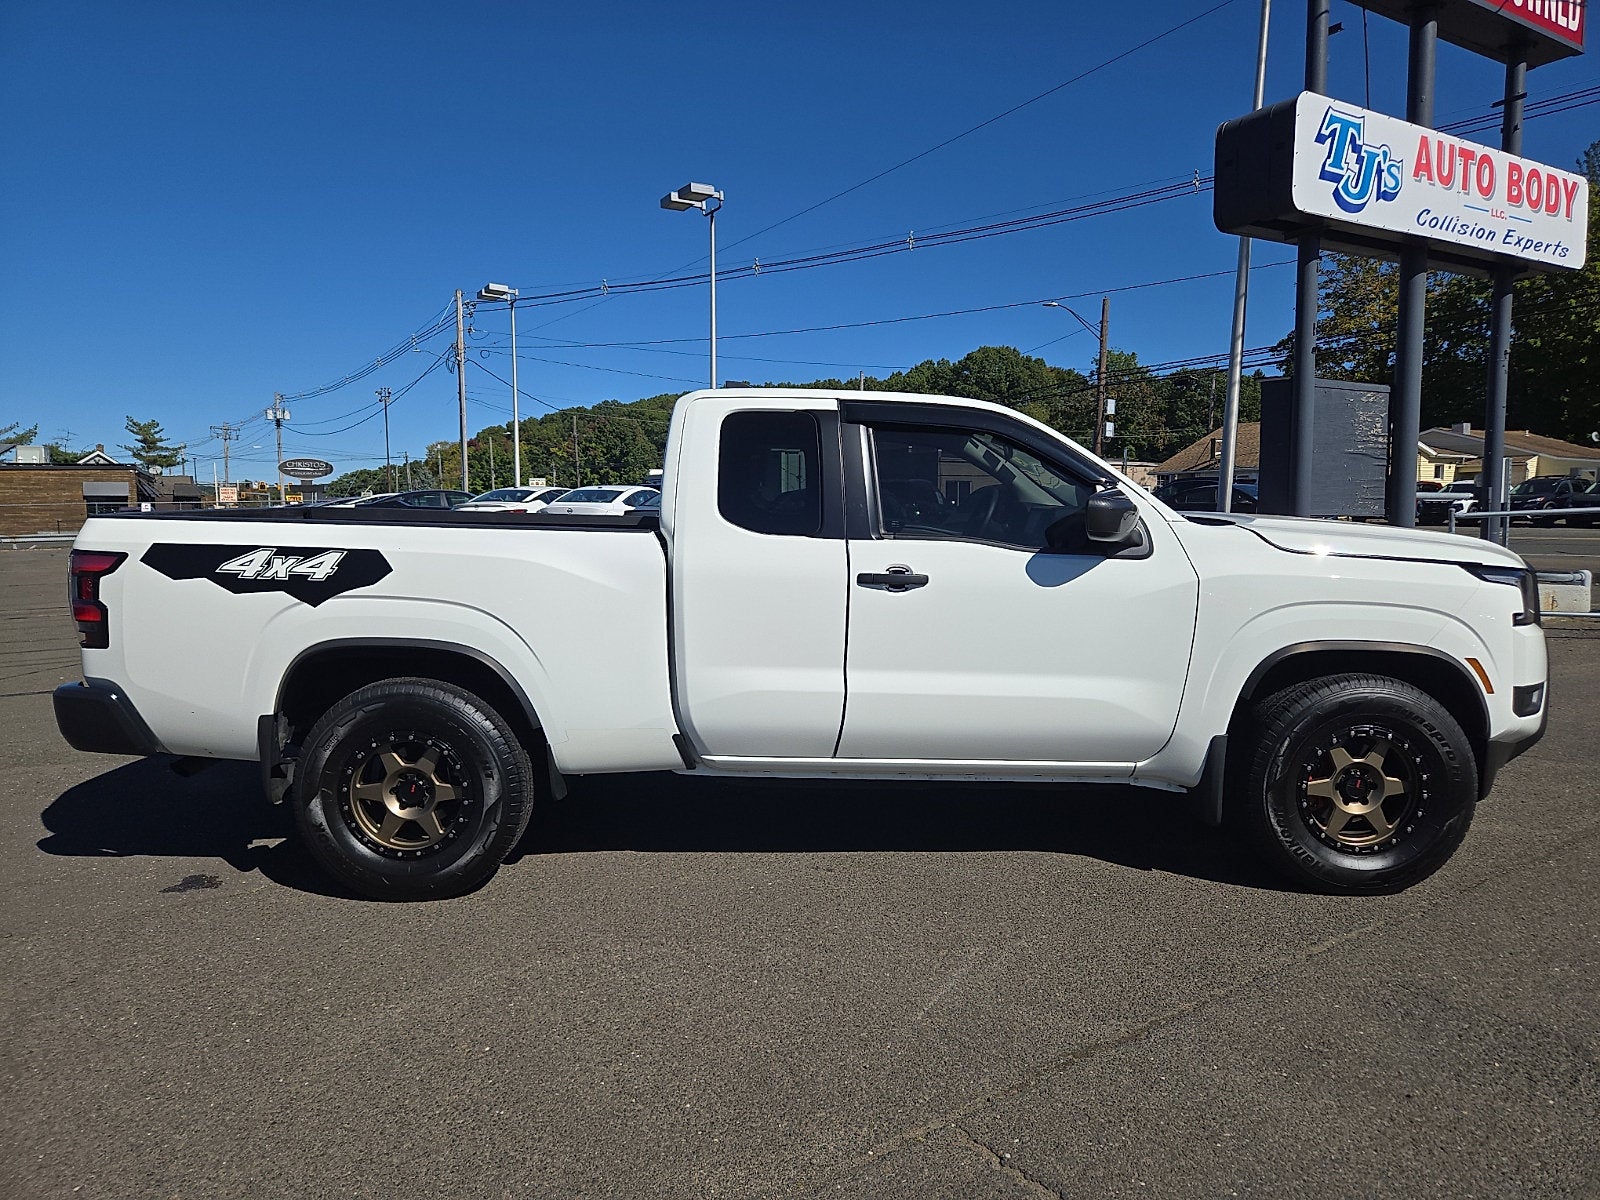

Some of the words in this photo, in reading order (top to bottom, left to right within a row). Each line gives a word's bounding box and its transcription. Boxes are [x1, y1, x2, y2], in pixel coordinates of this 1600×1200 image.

[1413, 135, 1496, 200] AUTO
[1506, 161, 1578, 221] BODY
[1416, 208, 1497, 245] Collision
[1502, 228, 1570, 259] Experts
[215, 547, 348, 581] 4x4
